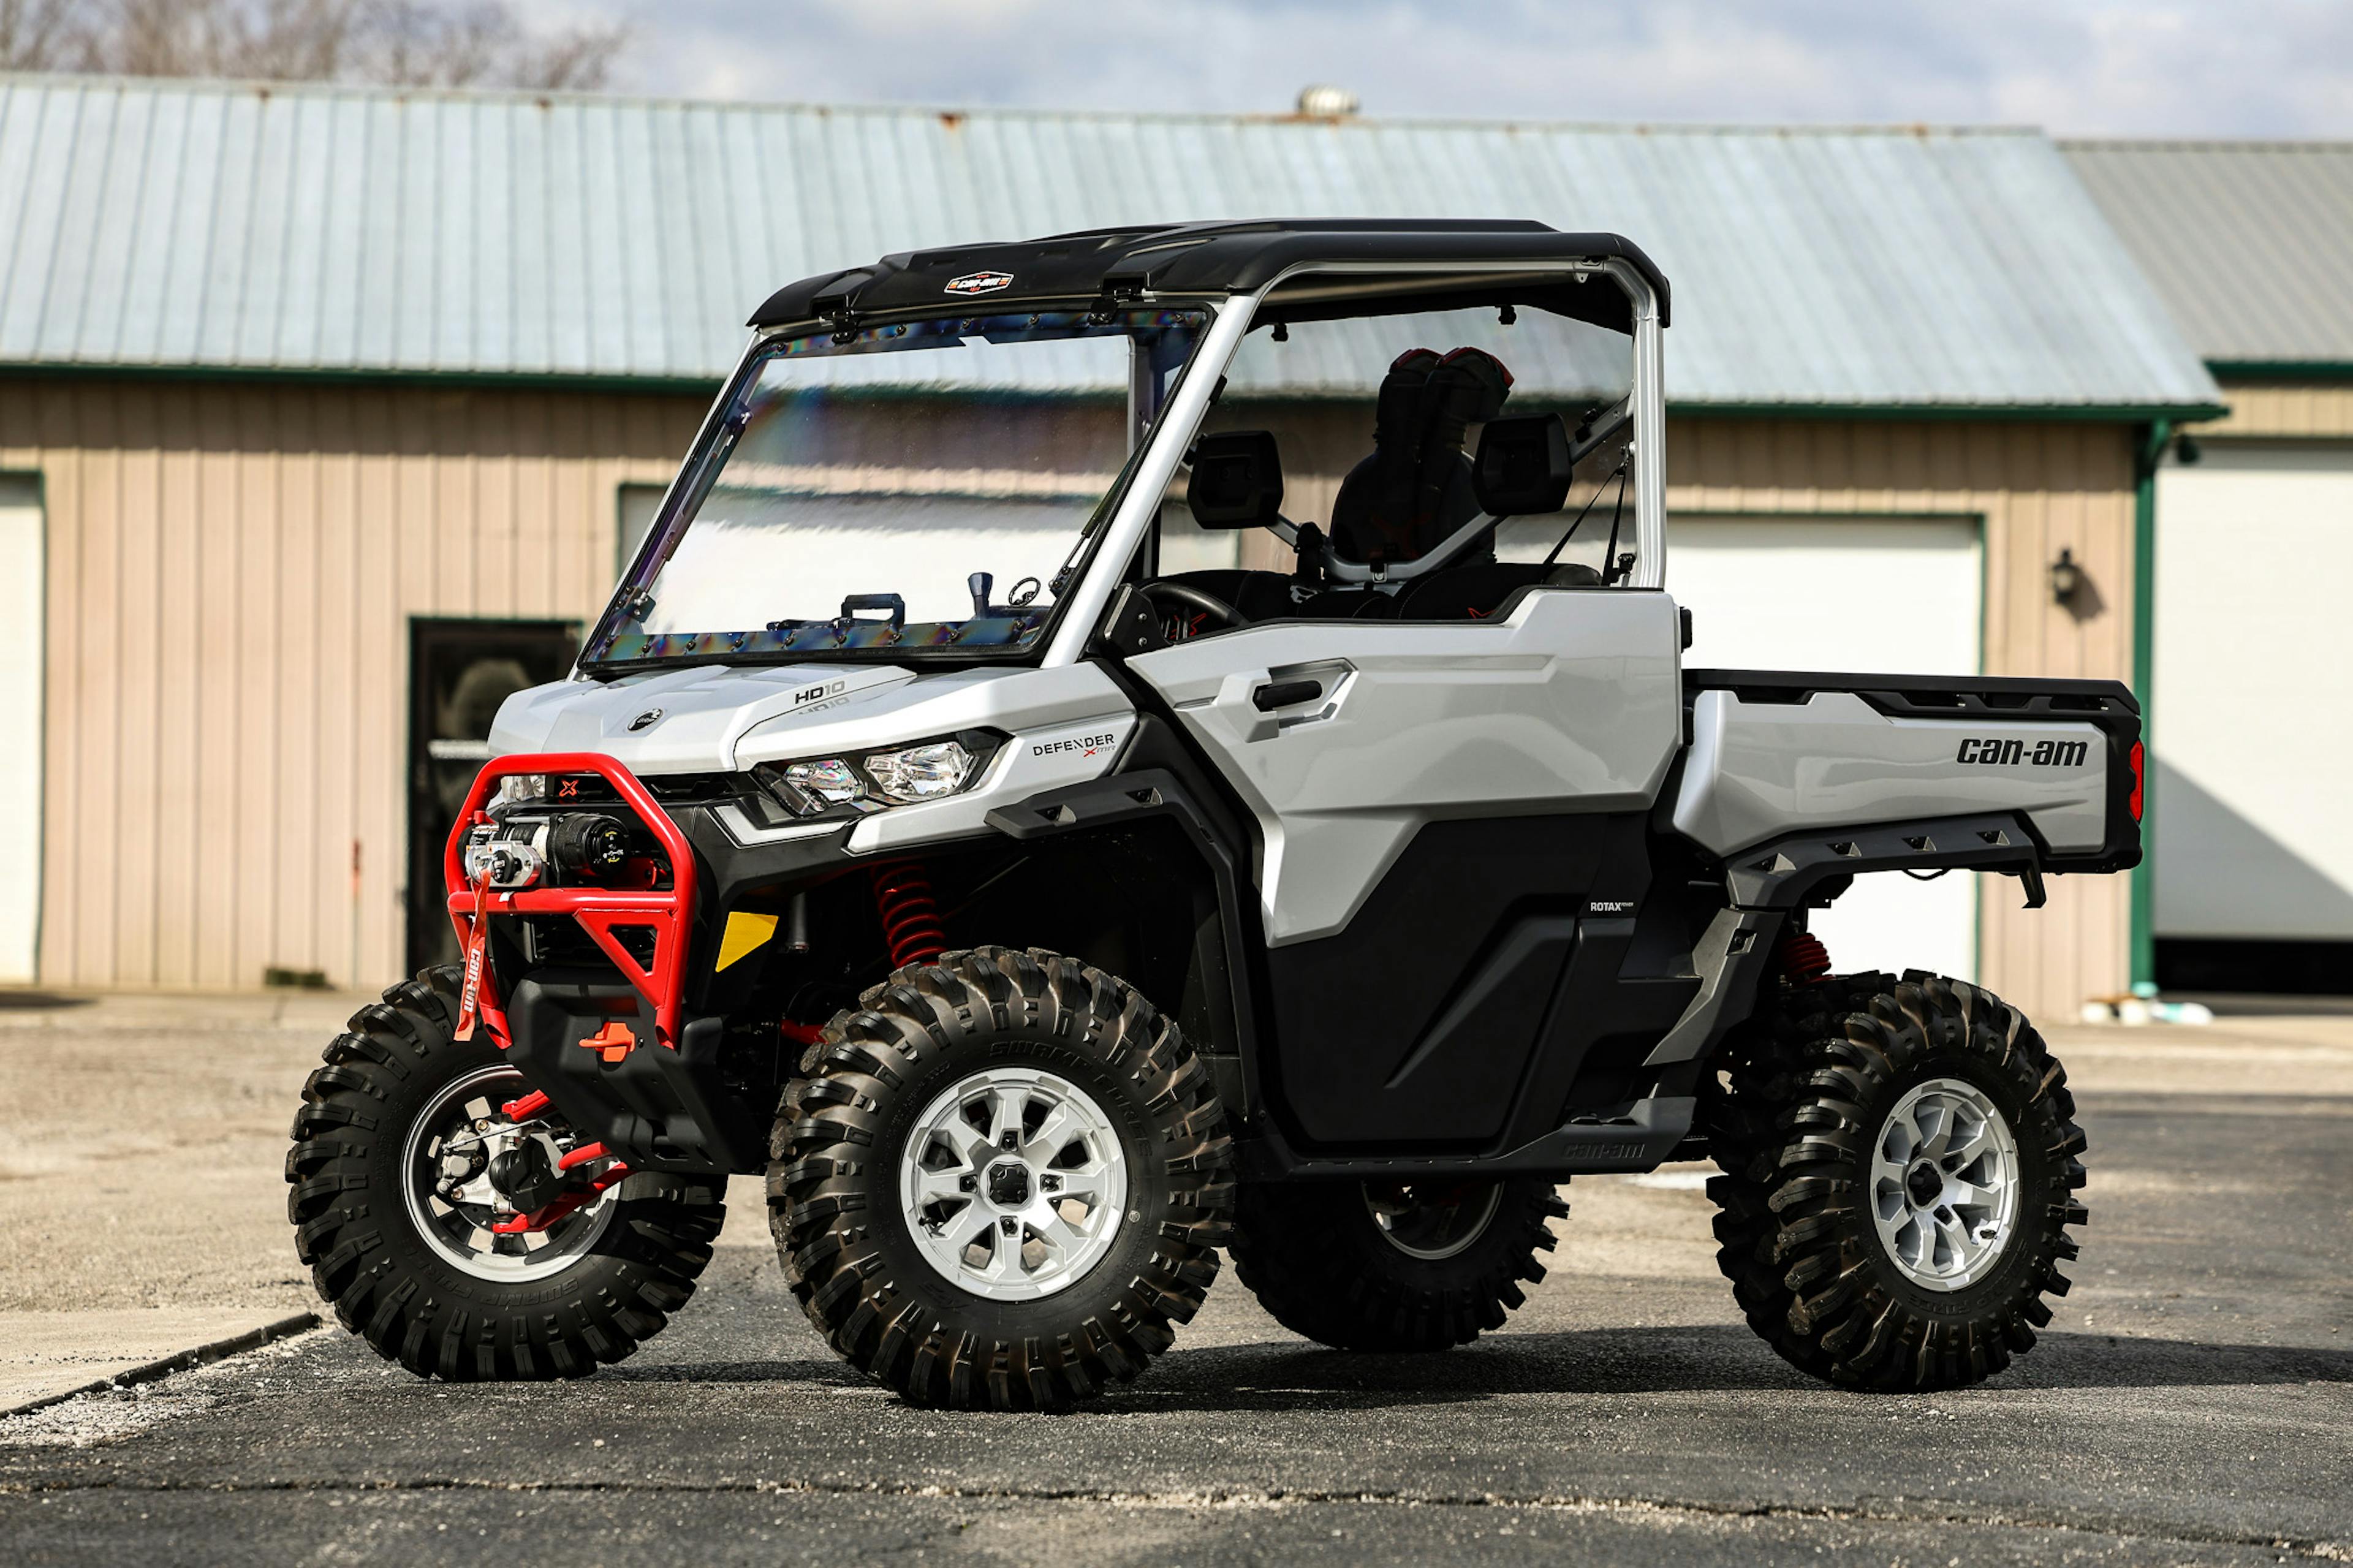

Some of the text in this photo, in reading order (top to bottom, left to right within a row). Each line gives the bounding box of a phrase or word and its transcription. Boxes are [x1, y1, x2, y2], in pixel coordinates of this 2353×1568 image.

[795, 681, 845, 705] HD10
[1033, 734, 1115, 756] DEFENDER
[1957, 739, 2088, 766] can-am
[1590, 902, 1622, 912] ROTAX
[464, 948, 481, 1013] can-am
[990, 1040, 1093, 1067] SWAMP
[480, 1278, 579, 1306] SWAMP
